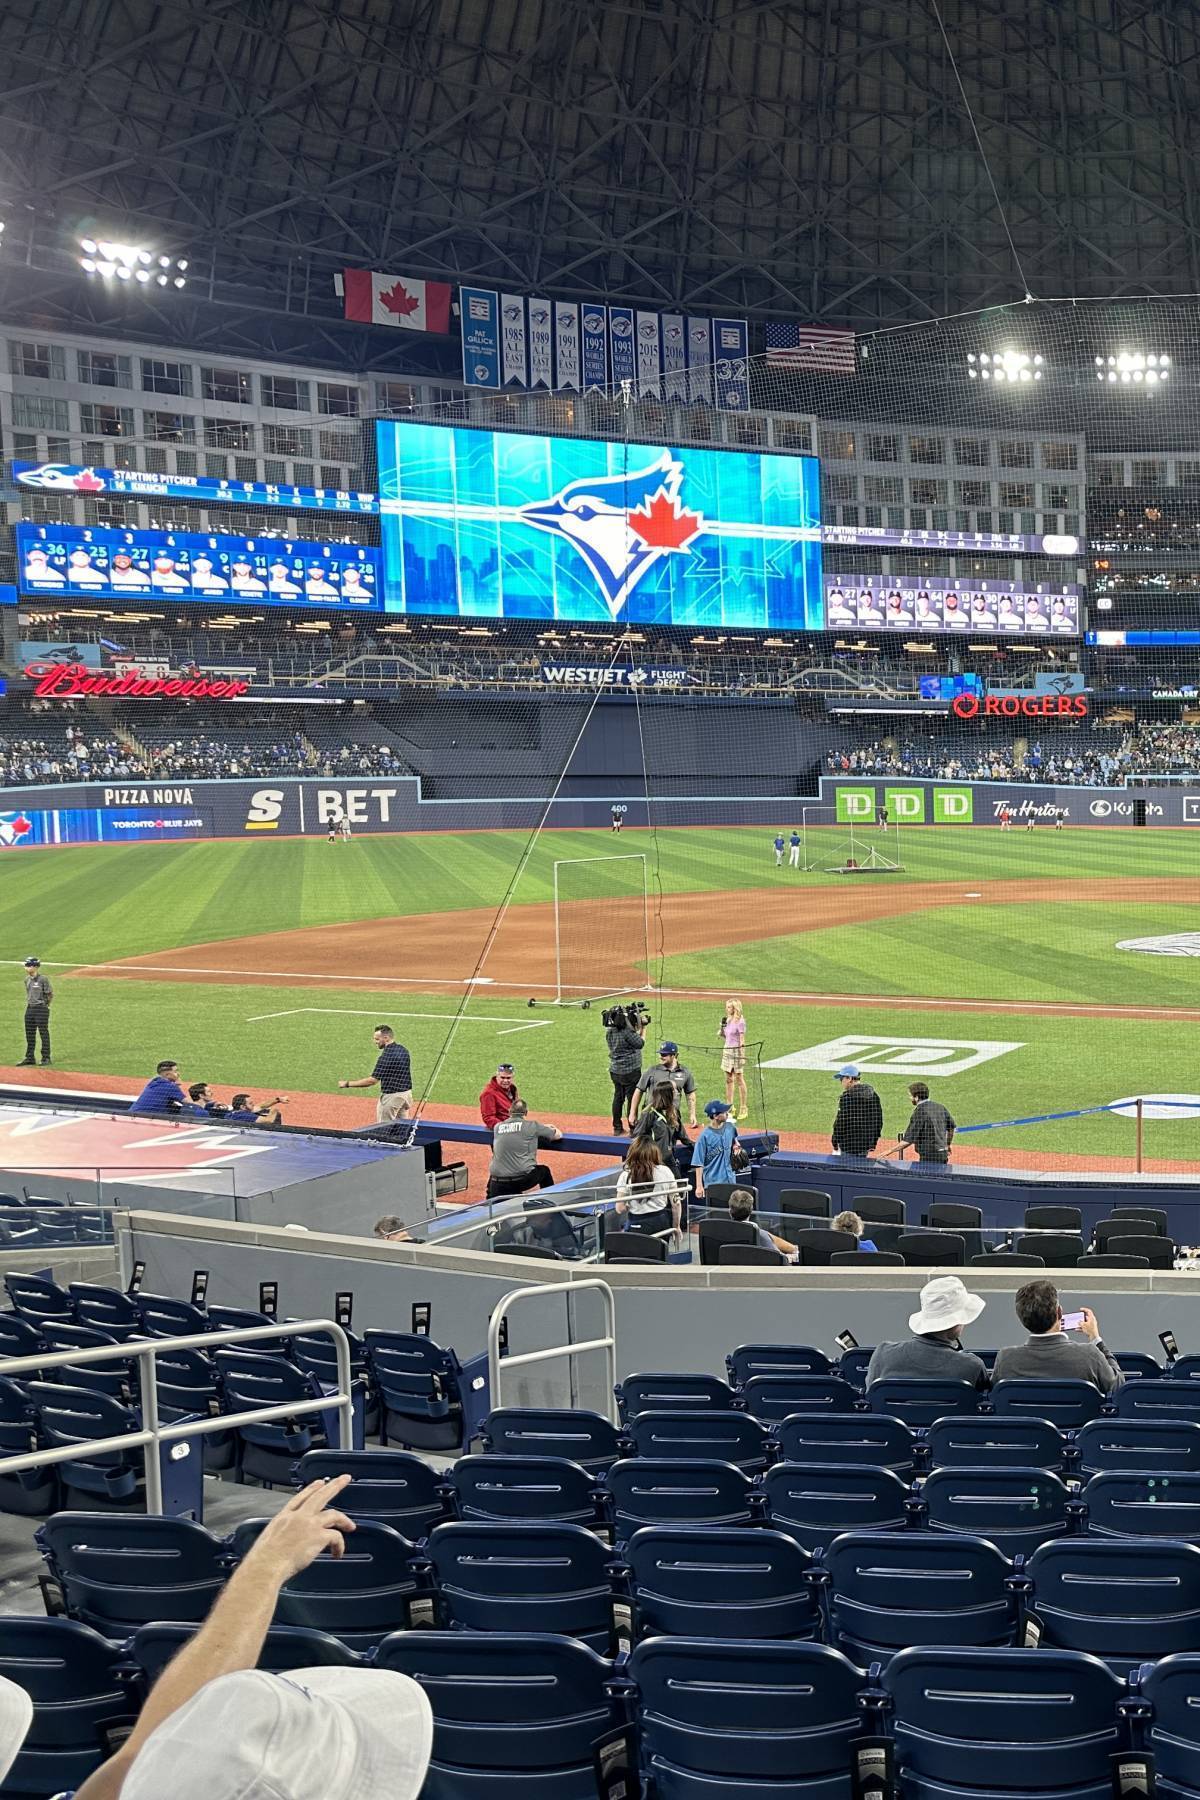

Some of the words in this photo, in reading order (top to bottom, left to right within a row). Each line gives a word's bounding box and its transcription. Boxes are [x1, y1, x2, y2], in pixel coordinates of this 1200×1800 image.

[467, 335, 494, 345] GILLICK
[504, 328, 523, 341] 1985
[532, 331, 549, 345] 1989
[559, 335, 576, 349] 1991
[585, 337, 604, 351] 1992
[614, 341, 631, 354] 1993
[640, 344, 658, 356] 2015
[665, 347, 684, 358] 2016
[506, 352, 523, 364] EAST
[533, 356, 549, 367] EAST
[559, 359, 577, 370] EAST
[716, 359, 747, 380] 32
[114, 470, 158, 483] STARTING
[160, 474, 197, 486] PITCHER
[132, 483, 168, 494] KIKUCHI
[824, 526, 856, 535] STARTING
[39, 528, 46, 540] 1
[84, 530, 93, 542] 2
[125, 533, 134, 545] 3
[167, 535, 176, 547] 4
[285, 543, 293, 555] 7
[47, 543, 66, 555] 36
[89, 546, 108, 558] 25
[131, 548, 149, 560] 27
[180, 551, 189, 562] 2
[219, 553, 229, 564] 9
[254, 556, 266, 567] 11
[294, 559, 303, 570] 8
[331, 561, 339, 572] 7
[358, 564, 373, 575] 28
[844, 589, 856, 598] 27
[879, 591, 885, 599] 4
[902, 591, 914, 600] 50
[931, 592, 942, 600] 64
[961, 593, 970, 602] 13
[987, 594, 997, 603] 30
[1015, 596, 1023, 604] 12
[24, 663, 249, 697] Budweiser
[543, 666, 626, 684] WESTJET
[651, 670, 686, 680] FLIGHT
[1184, 690, 1199, 698] DRY
[985, 696, 1087, 717] ROGERS
[105, 788, 149, 806] PIZZA
[153, 787, 193, 805] NOVA
[248, 789, 284, 821] S
[317, 789, 397, 824] BET
[611, 804, 628, 813] 400
[841, 794, 872, 815] TD
[889, 794, 921, 815] TD
[938, 794, 969, 815] TD
[993, 800, 1018, 816] Tim
[1019, 799, 1070, 816] Hortons
[112, 820, 155, 829] TORONTO
[164, 819, 182, 828] BLUE
[184, 819, 203, 828] JAYS
[498, 1121, 523, 1134] SECURITY
[178, 1446, 184, 1455] 3
